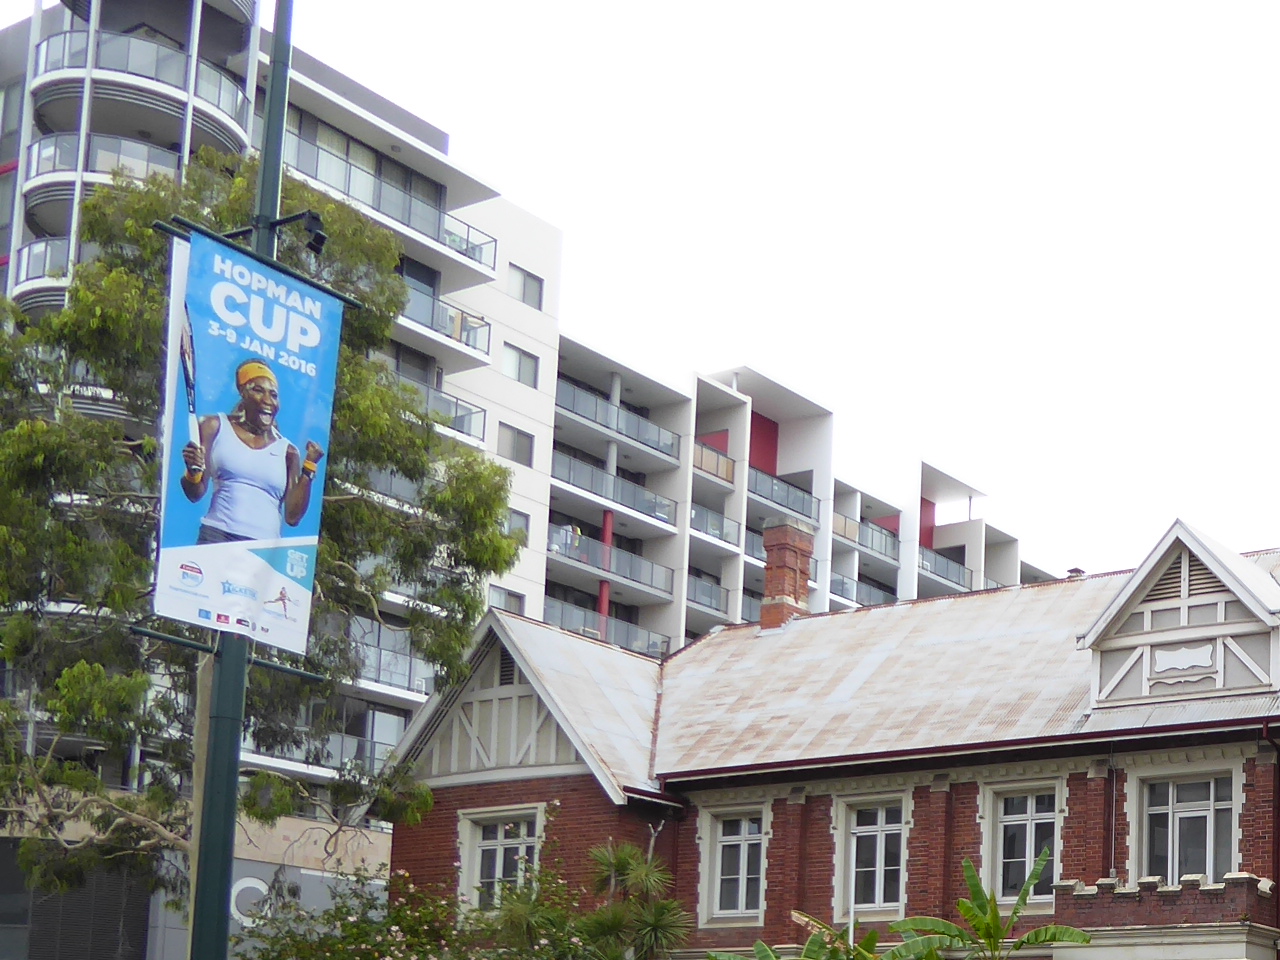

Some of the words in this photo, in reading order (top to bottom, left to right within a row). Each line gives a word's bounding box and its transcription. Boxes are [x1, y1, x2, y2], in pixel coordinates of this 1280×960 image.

[210, 281, 321, 354] CUP
[213, 254, 322, 320] HOPMAN
[208, 320, 237, 343] 3-9
[240, 336, 275, 361] JAN
[278, 351, 317, 377] 2016
[286, 561, 307, 579] UP
